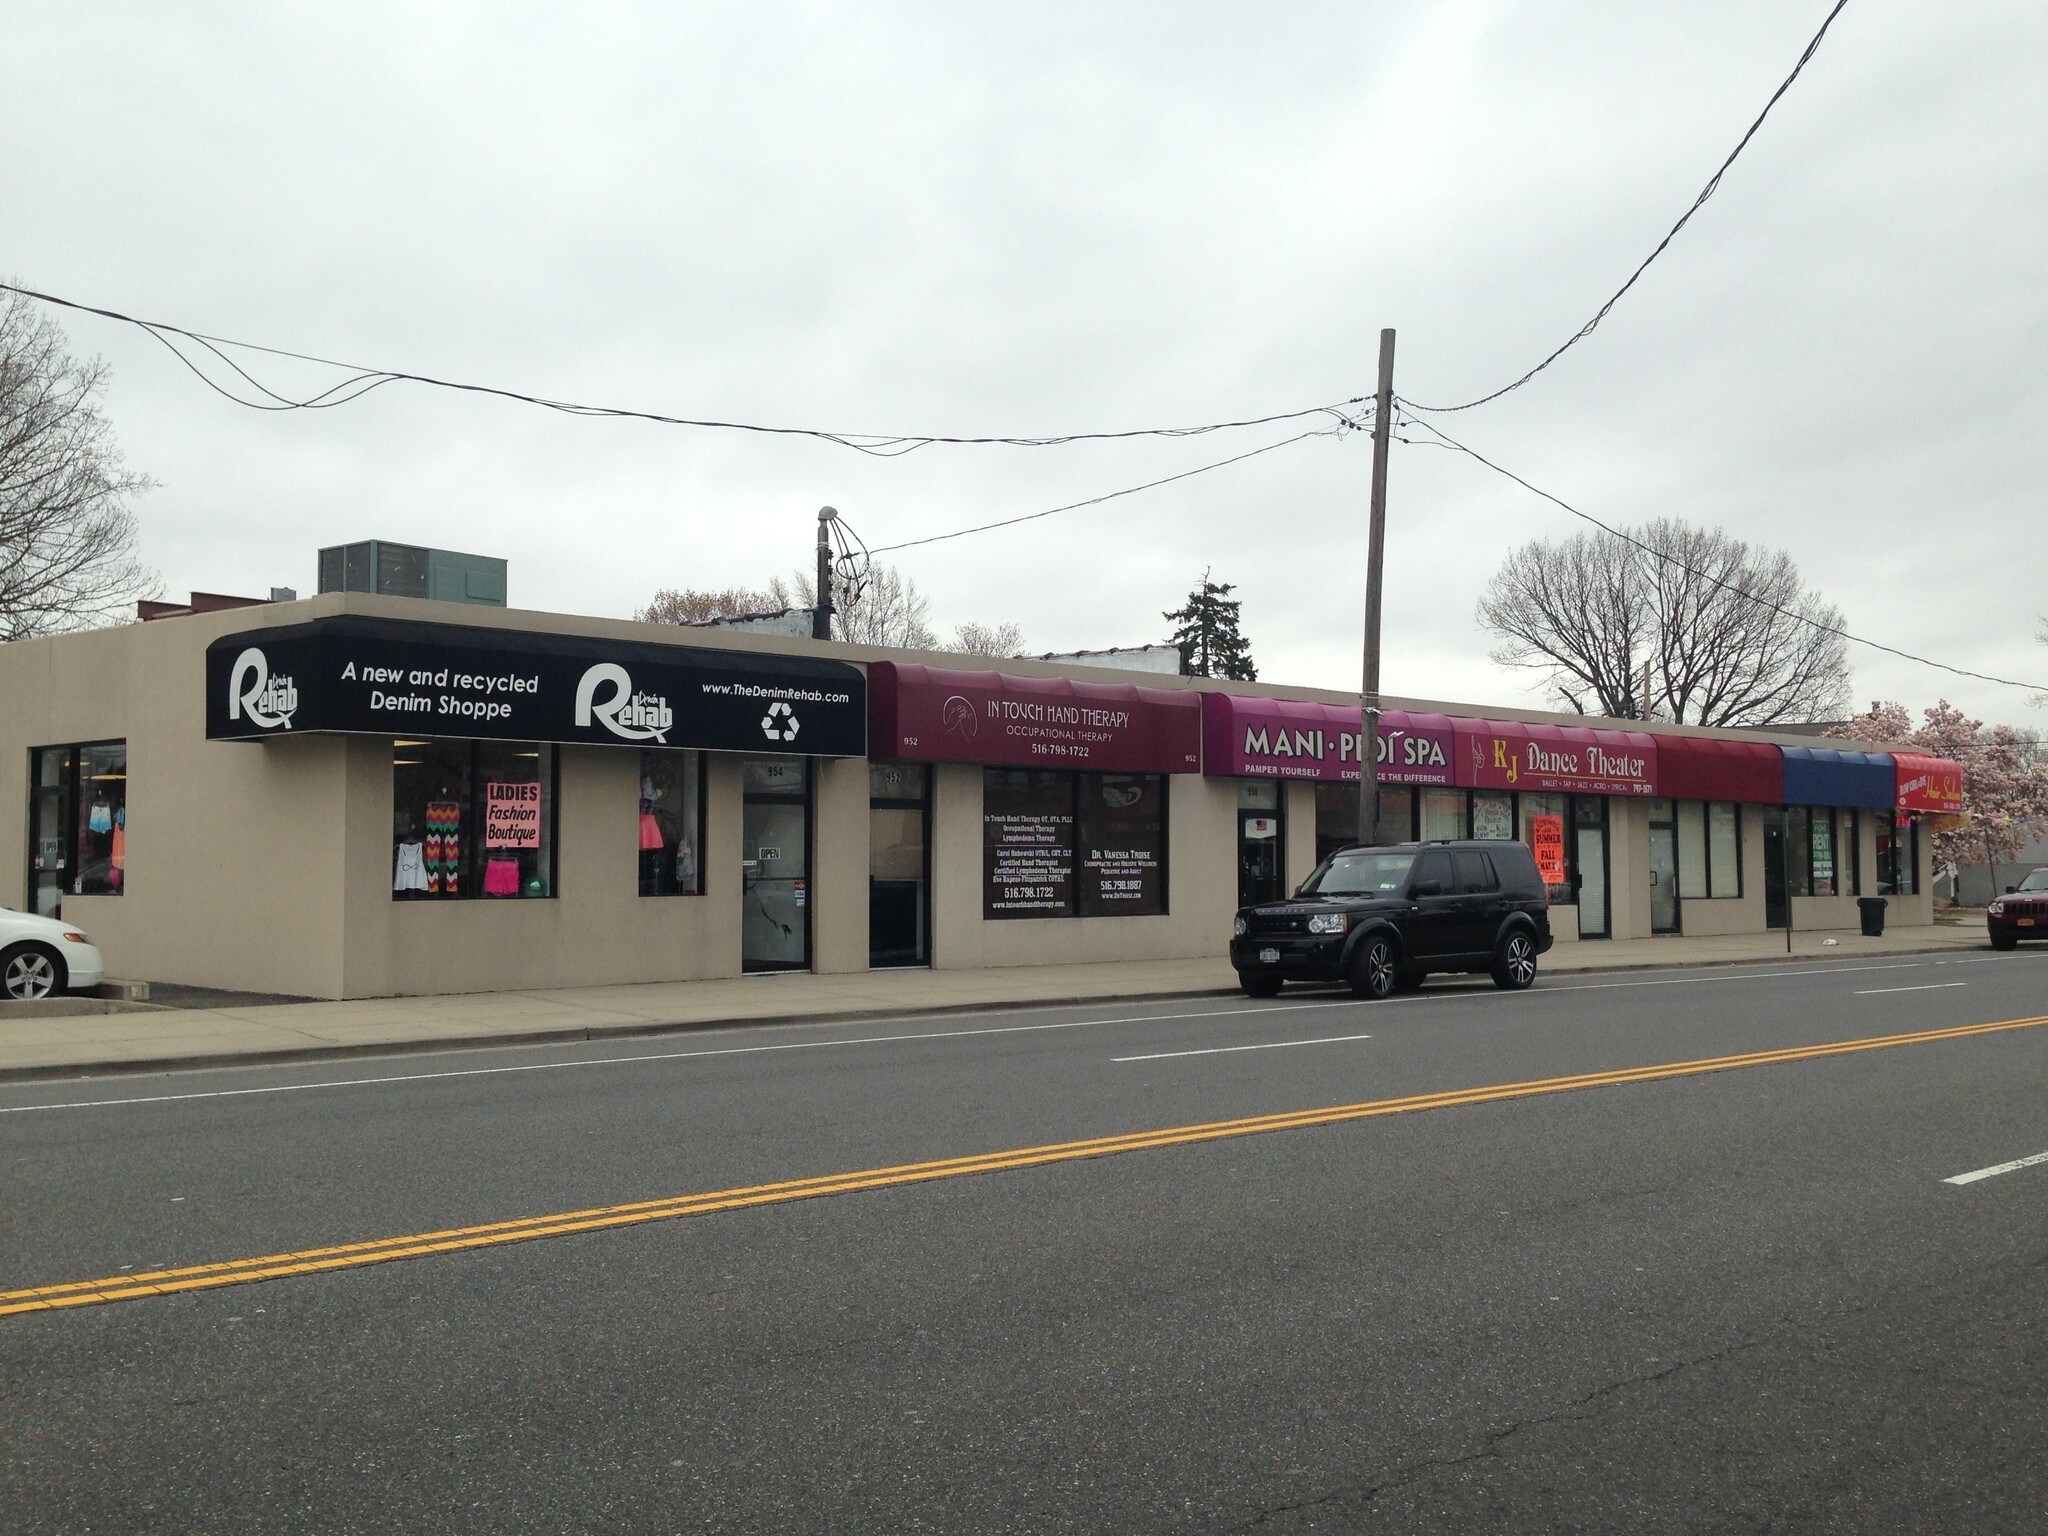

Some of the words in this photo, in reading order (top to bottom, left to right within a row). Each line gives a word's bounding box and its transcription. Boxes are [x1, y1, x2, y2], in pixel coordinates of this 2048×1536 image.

[340, 661, 356, 681] A
[362, 666, 403, 684] new
[409, 669, 448, 687] and
[453, 673, 538, 694] recycled
[229, 647, 298, 729] Rehab
[702, 683, 849, 703] www.TheDenimRehab.com
[370, 690, 432, 713] Denim
[438, 695, 512, 720] Shoppe
[575, 663, 673, 743] Rehab
[987, 700, 1000, 718] IN
[1002, 701, 1043, 721] TOUCH
[1047, 705, 1079, 725] HAND
[1081, 708, 1130, 728] THERAPY
[1006, 725, 1076, 740] OCCUPATIONAL
[1078, 731, 1113, 742] THERAPY
[903, 737, 918, 746] 952
[1403, 737, 1446, 766] SPA
[1185, 755, 1197, 763] 952
[1527, 742, 1578, 777] Dance
[1586, 746, 1644, 779] Theater
[768, 766, 783, 777] 954
[886, 772, 900, 783] 952
[1244, 764, 1278, 775] PAMPER
[1280, 767, 1321, 778] YOURSELF
[1341, 770, 1386, 780] EXPECE
[1388, 773, 1402, 781] THE
[1404, 774, 1446, 783] DIFFERENCE
[1542, 779, 1558, 787] BALLET
[1563, 780, 1571, 788] TAP
[1577, 781, 1588, 789] JAZZ
[489, 784, 537, 801] LADIES
[488, 804, 536, 820] Fashion
[1021, 815, 1040, 824] Therapy
[488, 823, 536, 845] Boutique
[1003, 824, 1035, 833] Occupational
[1035, 825, 1056, 833] Therapy
[1035, 834, 1056, 843] Therapy
[1536, 834, 1561, 844] SUMMER
[1813, 833, 1829, 850] RENT
[760, 848, 779, 859] OPEN
[1104, 850, 1129, 859] VANESSA
[1035, 859, 1058, 867] Therapist
[1004, 886, 1054, 898] 516.798.1722
[1100, 880, 1142, 890] 516.798.1887
